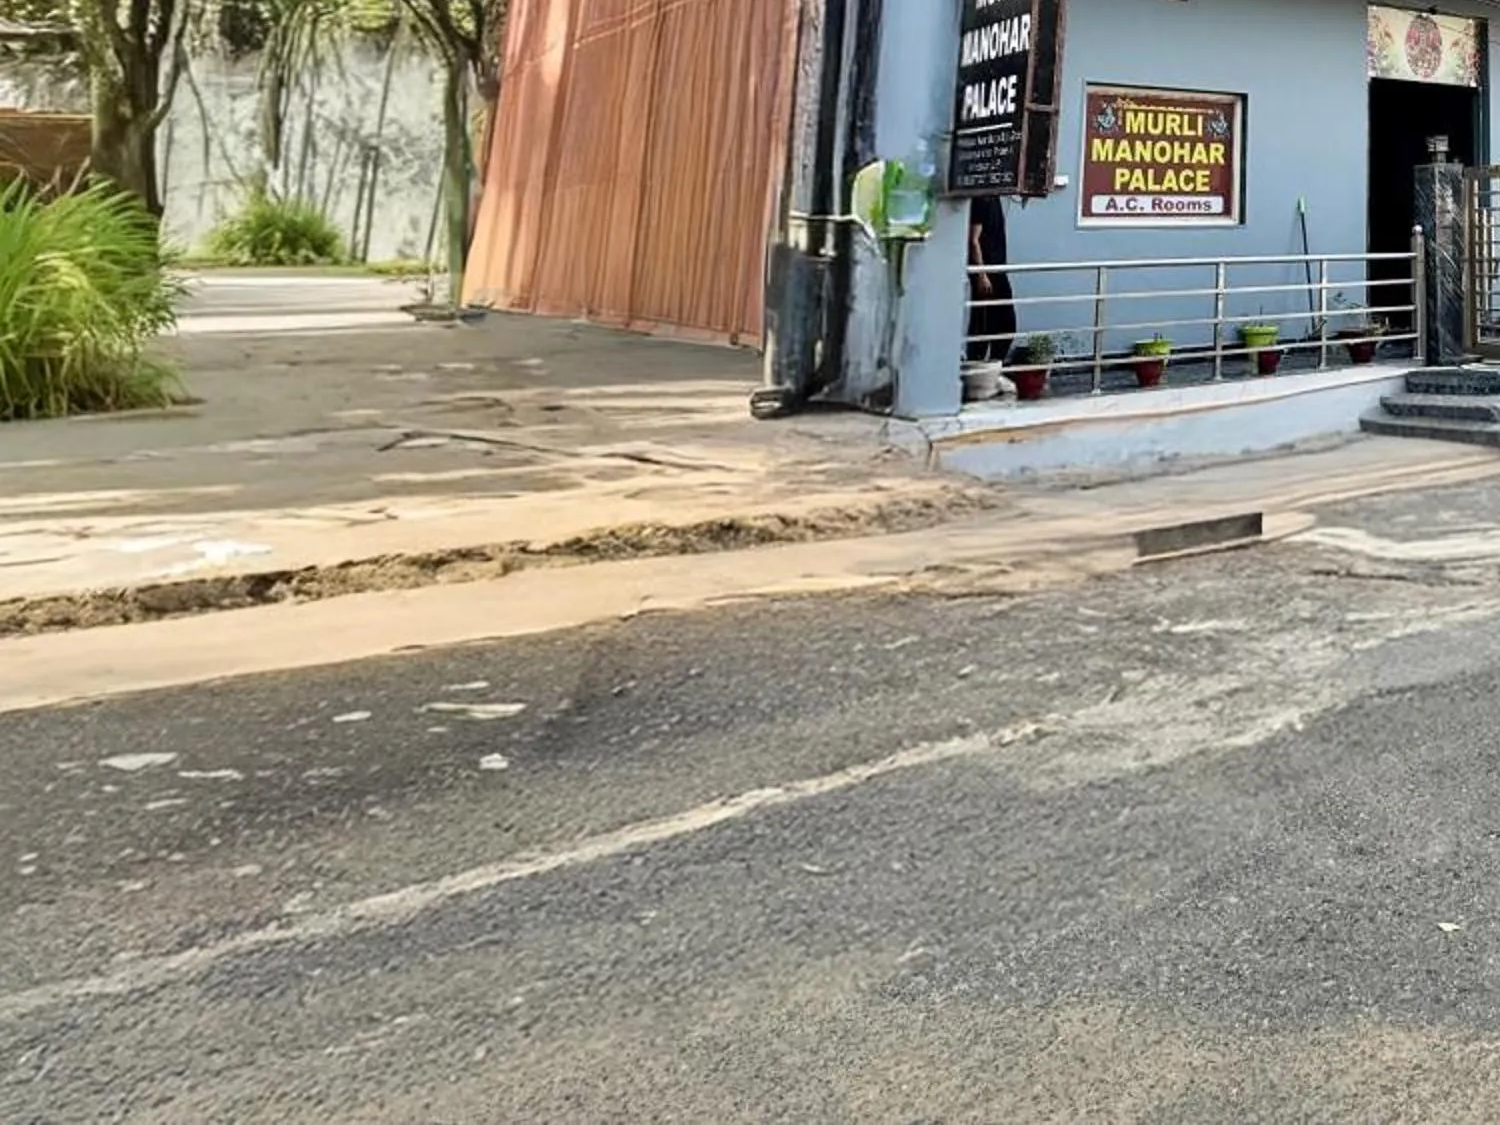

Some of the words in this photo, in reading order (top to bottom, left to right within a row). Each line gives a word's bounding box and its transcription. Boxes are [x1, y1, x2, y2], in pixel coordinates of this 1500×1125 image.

[961, 13, 1031, 66] MANOHAR
[961, 74, 1017, 121] PALACE
[1125, 110, 1204, 137] MURLI
[1091, 138, 1225, 165] MANOHAR
[1114, 167, 1211, 192] PALACE
[1105, 196, 1145, 212] A.C.
[1151, 197, 1213, 213] Rooms
